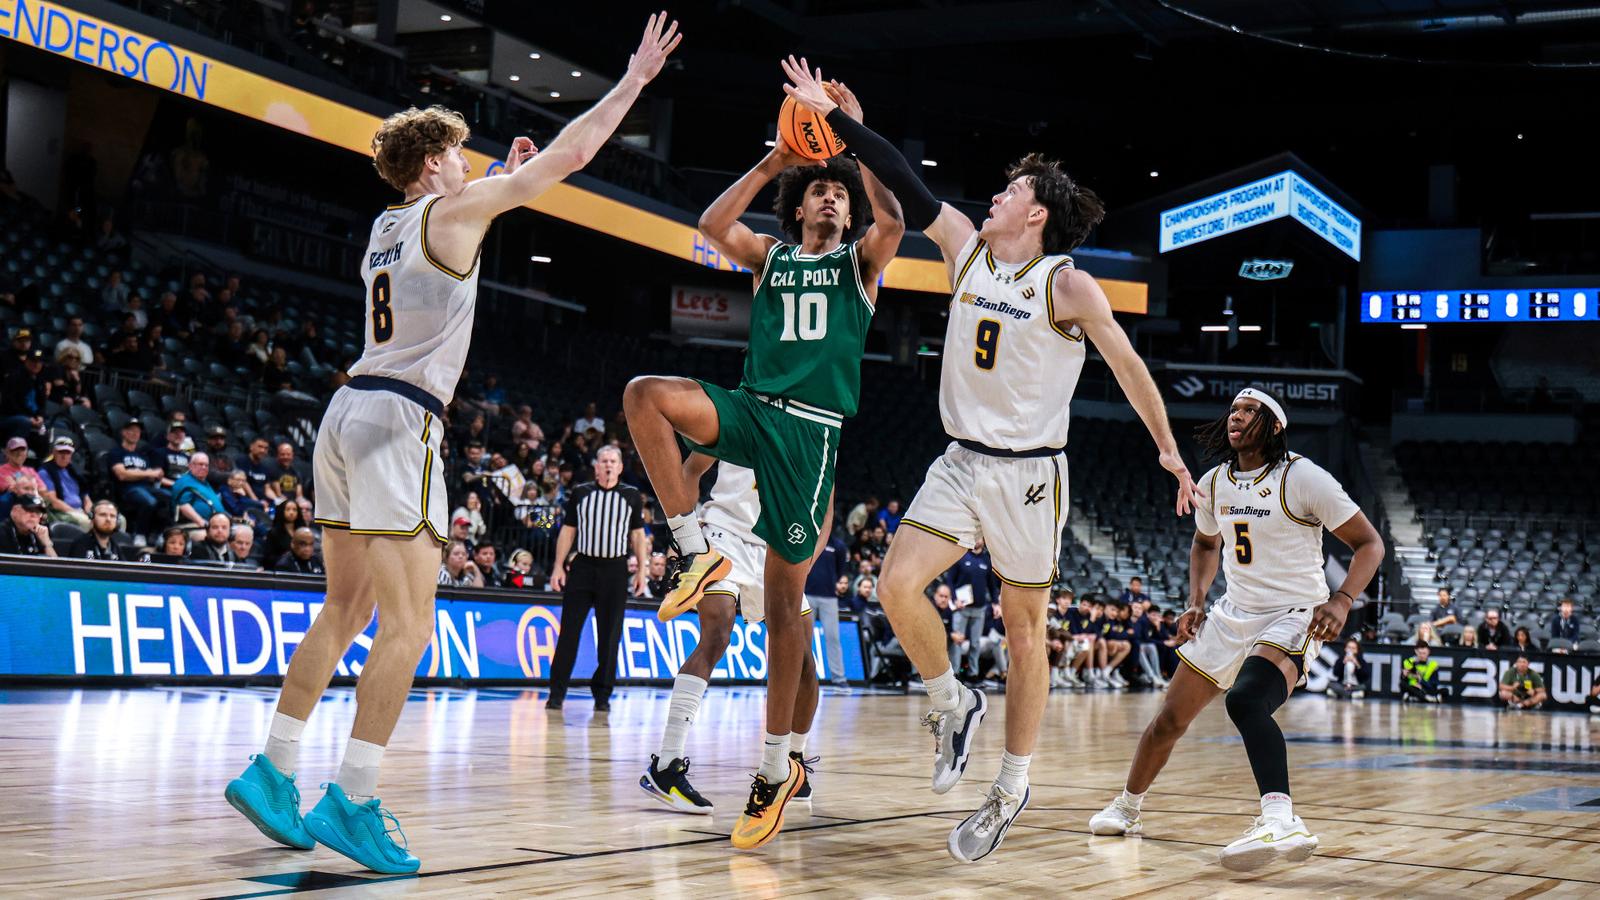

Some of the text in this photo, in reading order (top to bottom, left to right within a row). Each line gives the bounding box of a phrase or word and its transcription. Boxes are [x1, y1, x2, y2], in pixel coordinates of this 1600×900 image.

[801, 121, 823, 154] NCAA
[1165, 177, 1286, 228] CHAMPIONSHIPS PROGRAM AT
[1232, 202, 1275, 226] PROGRAM
[676, 289, 729, 312] Lee's
[770, 268, 841, 287] CAL POLY
[372, 271, 394, 343] 8
[780, 292, 828, 341] 10
[974, 317, 1002, 371] 9
[1287, 383, 1339, 400] WEST
[1232, 521, 1253, 567] 5
[69, 590, 481, 678] HENDEN
